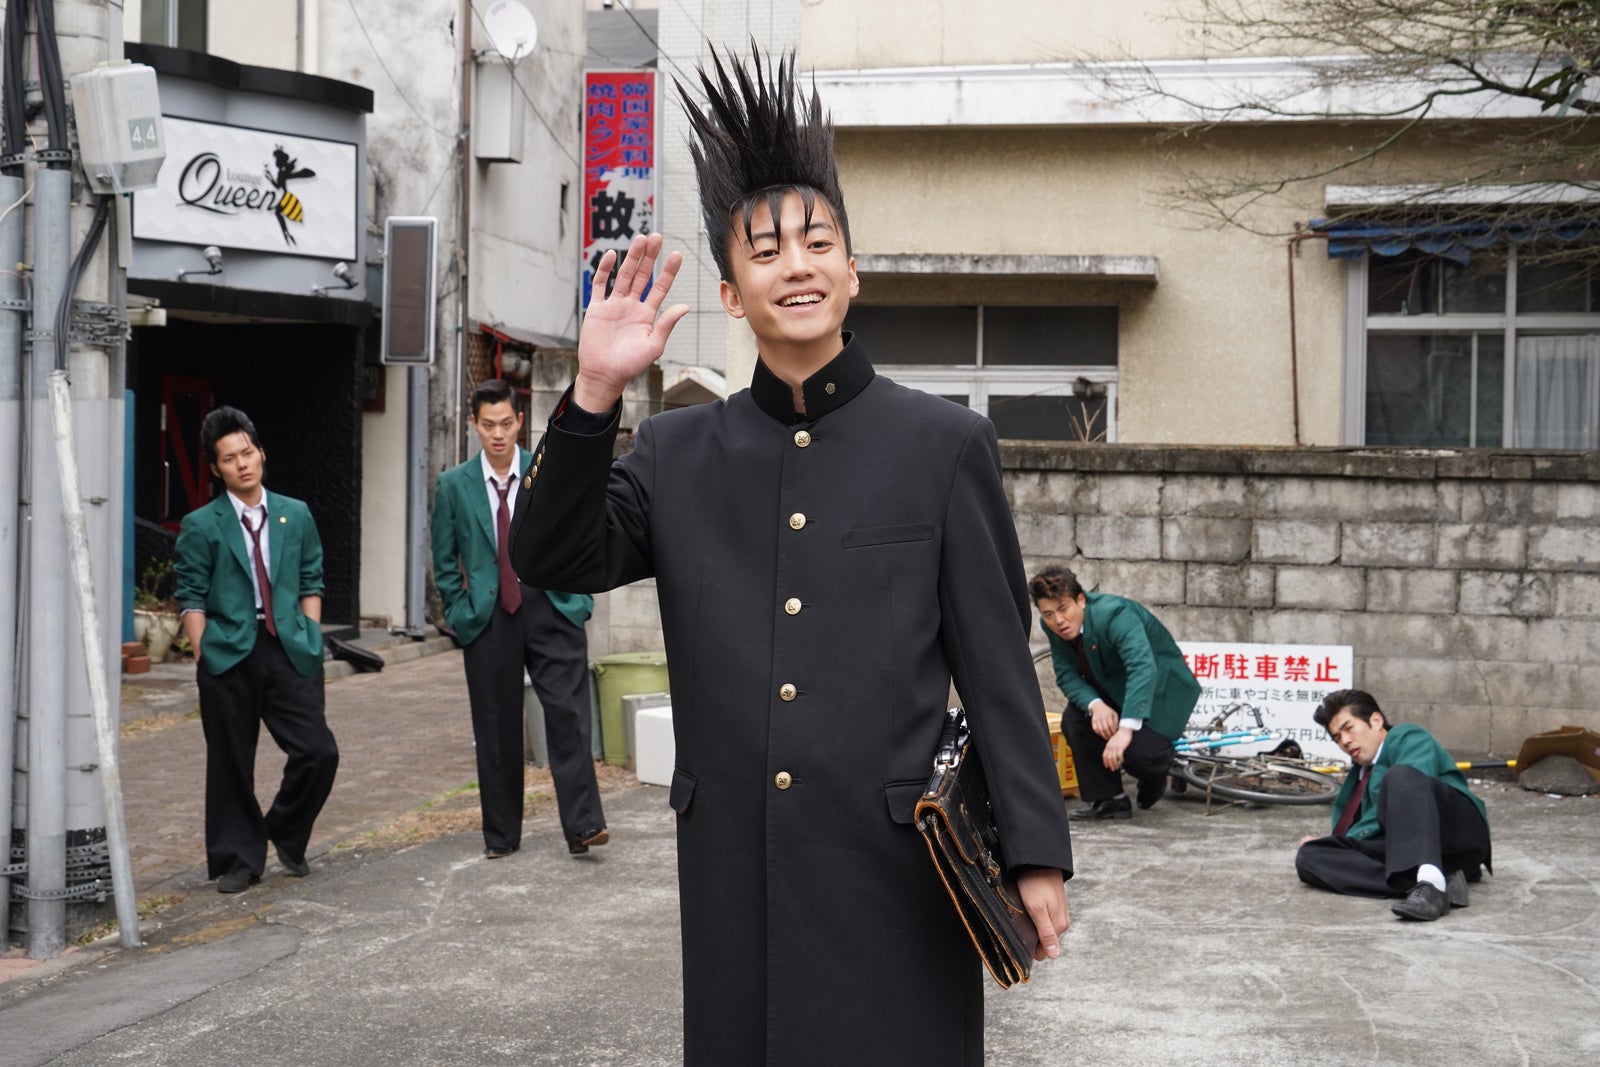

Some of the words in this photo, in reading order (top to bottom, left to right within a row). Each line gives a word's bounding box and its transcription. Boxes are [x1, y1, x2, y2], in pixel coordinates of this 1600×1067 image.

[132, 124, 156, 143] 44
[588, 83, 617, 181] 焼肉・ランチ
[622, 82, 650, 179] 韓国家庭料理
[175, 152, 277, 216] Queen
[1182, 653, 1340, 682] 断駐車禁止
[1200, 686, 1334, 702] 所に車やゴミを無断
